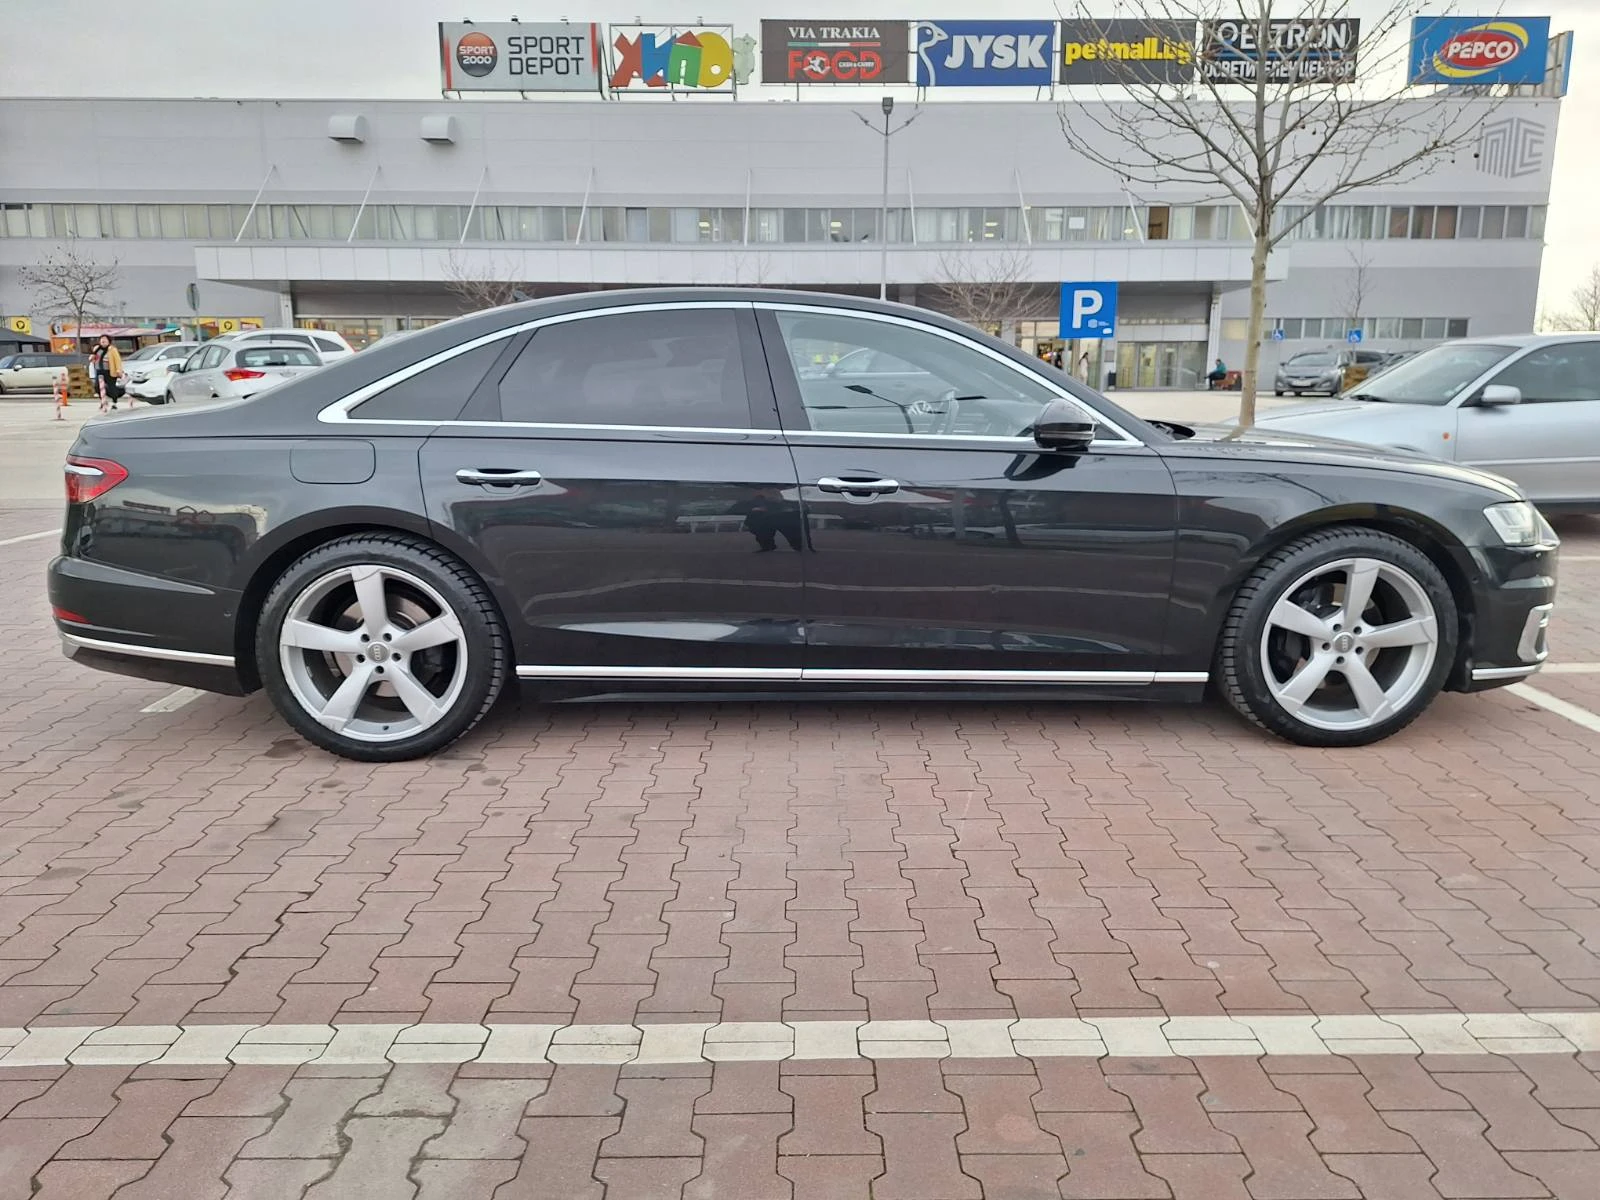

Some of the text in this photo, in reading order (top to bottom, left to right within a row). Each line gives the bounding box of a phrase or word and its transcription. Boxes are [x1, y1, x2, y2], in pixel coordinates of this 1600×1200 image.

[788, 26, 881, 39] VIA TRAKIA
[459, 46, 494, 54] SPORT
[508, 36, 585, 54] SPORT
[944, 35, 1049, 69] JYSK
[1446, 41, 1514, 59] PEPCO
[463, 55, 492, 64] 2000
[509, 57, 585, 75] DEPOT
[788, 50, 882, 80] FOOD
[1072, 290, 1103, 329] P
